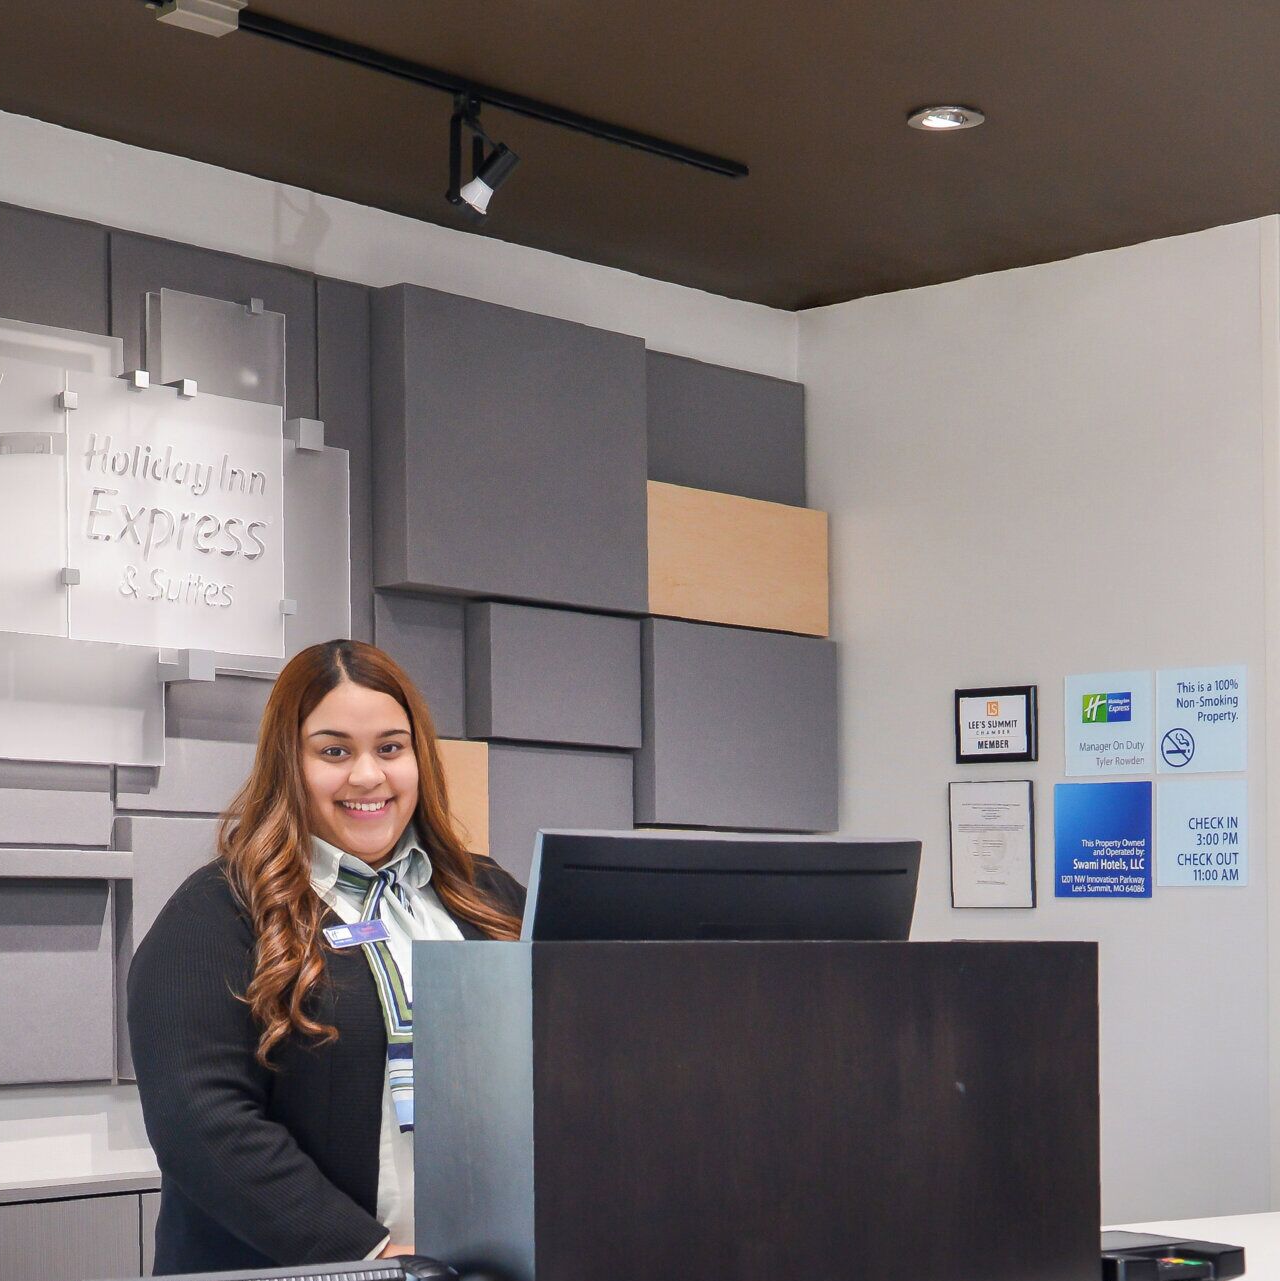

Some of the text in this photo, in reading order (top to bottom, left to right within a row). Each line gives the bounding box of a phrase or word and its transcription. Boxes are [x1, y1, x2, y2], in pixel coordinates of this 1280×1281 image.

[84, 433, 267, 497] Holiday Inn
[86, 487, 271, 562] Express
[119, 565, 235, 608] & Suites
[1176, 679, 1239, 694] This is a 100%
[1176, 694, 1239, 708] Non-Smoking
[1108, 705, 1131, 714] Express
[1197, 711, 1239, 724] Property.
[968, 719, 1018, 730] LEE'S SUMMIT
[977, 739, 1009, 750] MEMBER
[1079, 740, 1145, 753] Manager On Duty
[1096, 757, 1113, 768] Tyler
[1188, 816, 1239, 830] CHECK IN
[1081, 838, 1146, 849] This Property Owned
[1196, 831, 1239, 846] 3:00 PM
[1092, 848, 1105, 856] and
[1105, 847, 1134, 857] Operated
[1073, 858, 1145, 871] Swami Hotels, LLC
[1177, 852, 1240, 867] CHECK OUT
[1074, 875, 1086, 883] NW
[1086, 875, 1119, 884] Innovation
[1119, 875, 1145, 885] Parkway
[1193, 868, 1239, 881] 11:00 AM
[1071, 884, 1087, 892] Lee's
[1087, 884, 1112, 893] Summit,
[1113, 884, 1125, 892] MO
